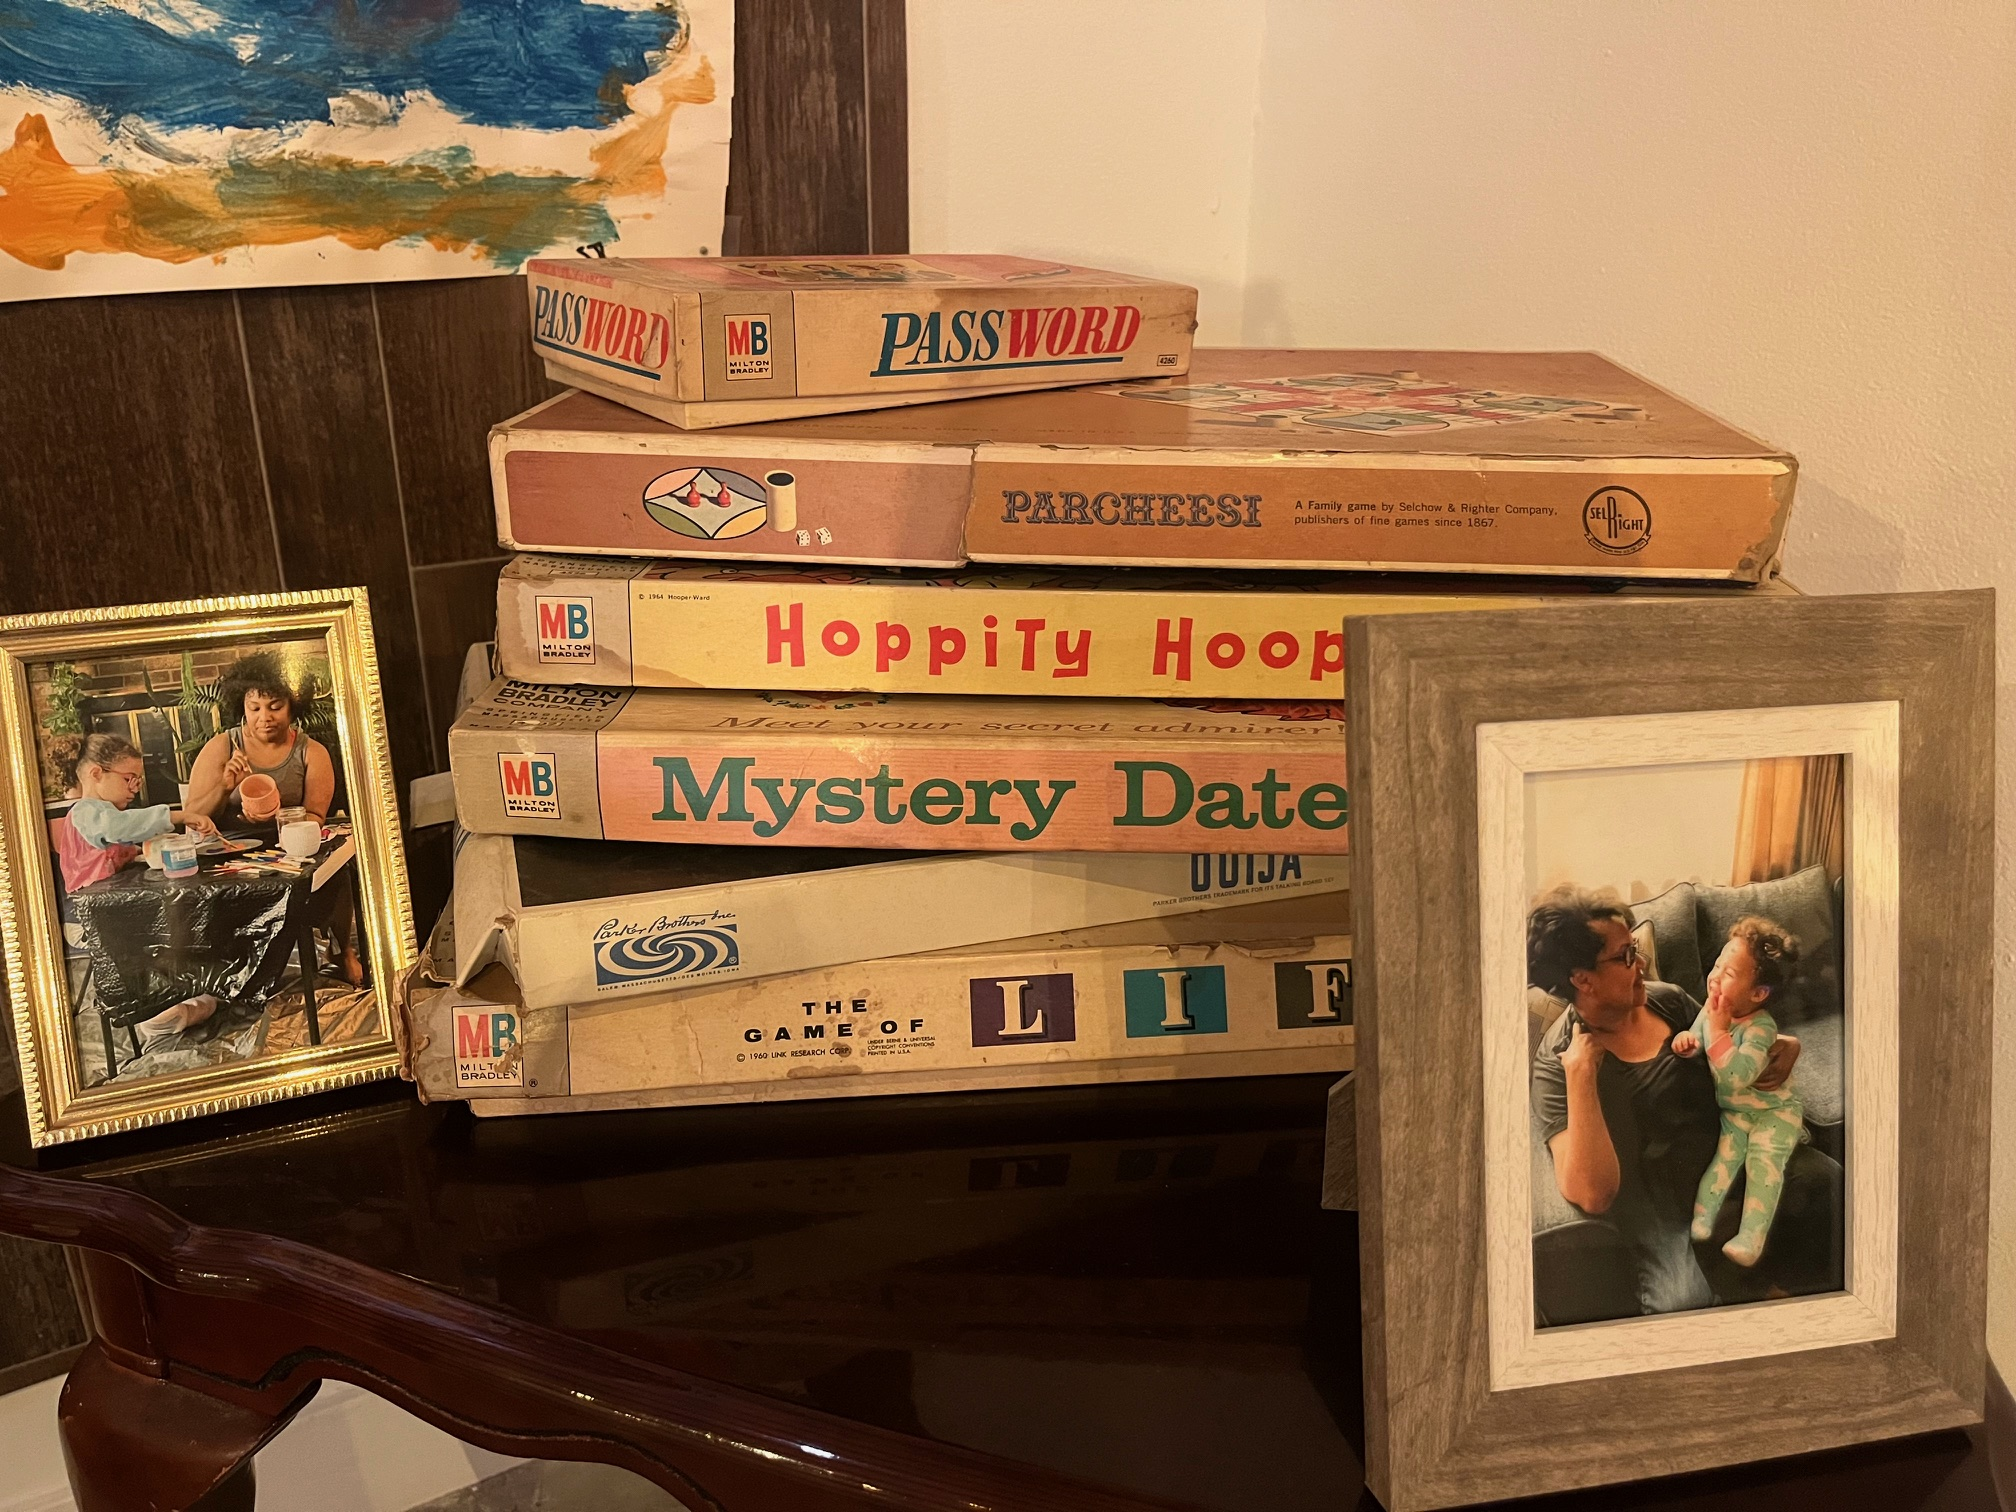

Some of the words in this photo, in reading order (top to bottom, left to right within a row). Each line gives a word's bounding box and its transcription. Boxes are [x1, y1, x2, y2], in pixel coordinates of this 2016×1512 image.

[534, 285, 670, 369] PASSWORD
[728, 321, 768, 355] MB
[870, 305, 1141, 377] PASSWORD
[1001, 490, 1262, 527] PARCHEESI
[1295, 501, 1303, 509] A
[1308, 501, 1342, 512] Family
[1348, 503, 1376, 513] game
[1382, 502, 1394, 513] by
[1399, 502, 1443, 512] Selchow
[1448, 503, 1456, 513] &
[1461, 504, 1500, 515] Righter
[1505, 505, 1558, 516] Company,
[1295, 515, 1349, 525] publishers
[1354, 516, 1365, 525] of
[1370, 516, 1390, 525] fine
[1395, 518, 1429, 528] games
[1435, 517, 1462, 527] since
[1468, 518, 1498, 528] 1867.
[540, 604, 589, 639] MB
[1153, 617, 1344, 681] Hoop
[498, 688, 617, 708] BRADLEY
[506, 680, 622, 700] MILTON
[493, 698, 609, 712] COMPANY
[709, 716, 834, 729] Meet
[846, 721, 964, 731] your
[980, 722, 1115, 732] secret
[1134, 722, 1345, 735] admirer!
[504, 761, 554, 796] MB
[652, 757, 1077, 841] Mystery
[1113, 761, 1349, 830] Date
[1191, 853, 1302, 892] OUIJA
[1153, 898, 1178, 906] PARKER
[1179, 894, 1211, 904] BROTHERS
[1213, 888, 1250, 899] TRADEMARK
[593, 918, 647, 940] Parker
[648, 914, 706, 933] Brothers
[802, 999, 867, 1016] THE
[458, 1013, 518, 1058] MB
[744, 1023, 853, 1043] GAME
[881, 1019, 924, 1034] OF
[750, 1052, 768, 1060] 1960
[772, 1051, 787, 1059] LINK
[791, 1049, 826, 1058] RESEARCH
[461, 1063, 518, 1071] MILTN
[461, 1072, 517, 1080] BRADLEY
